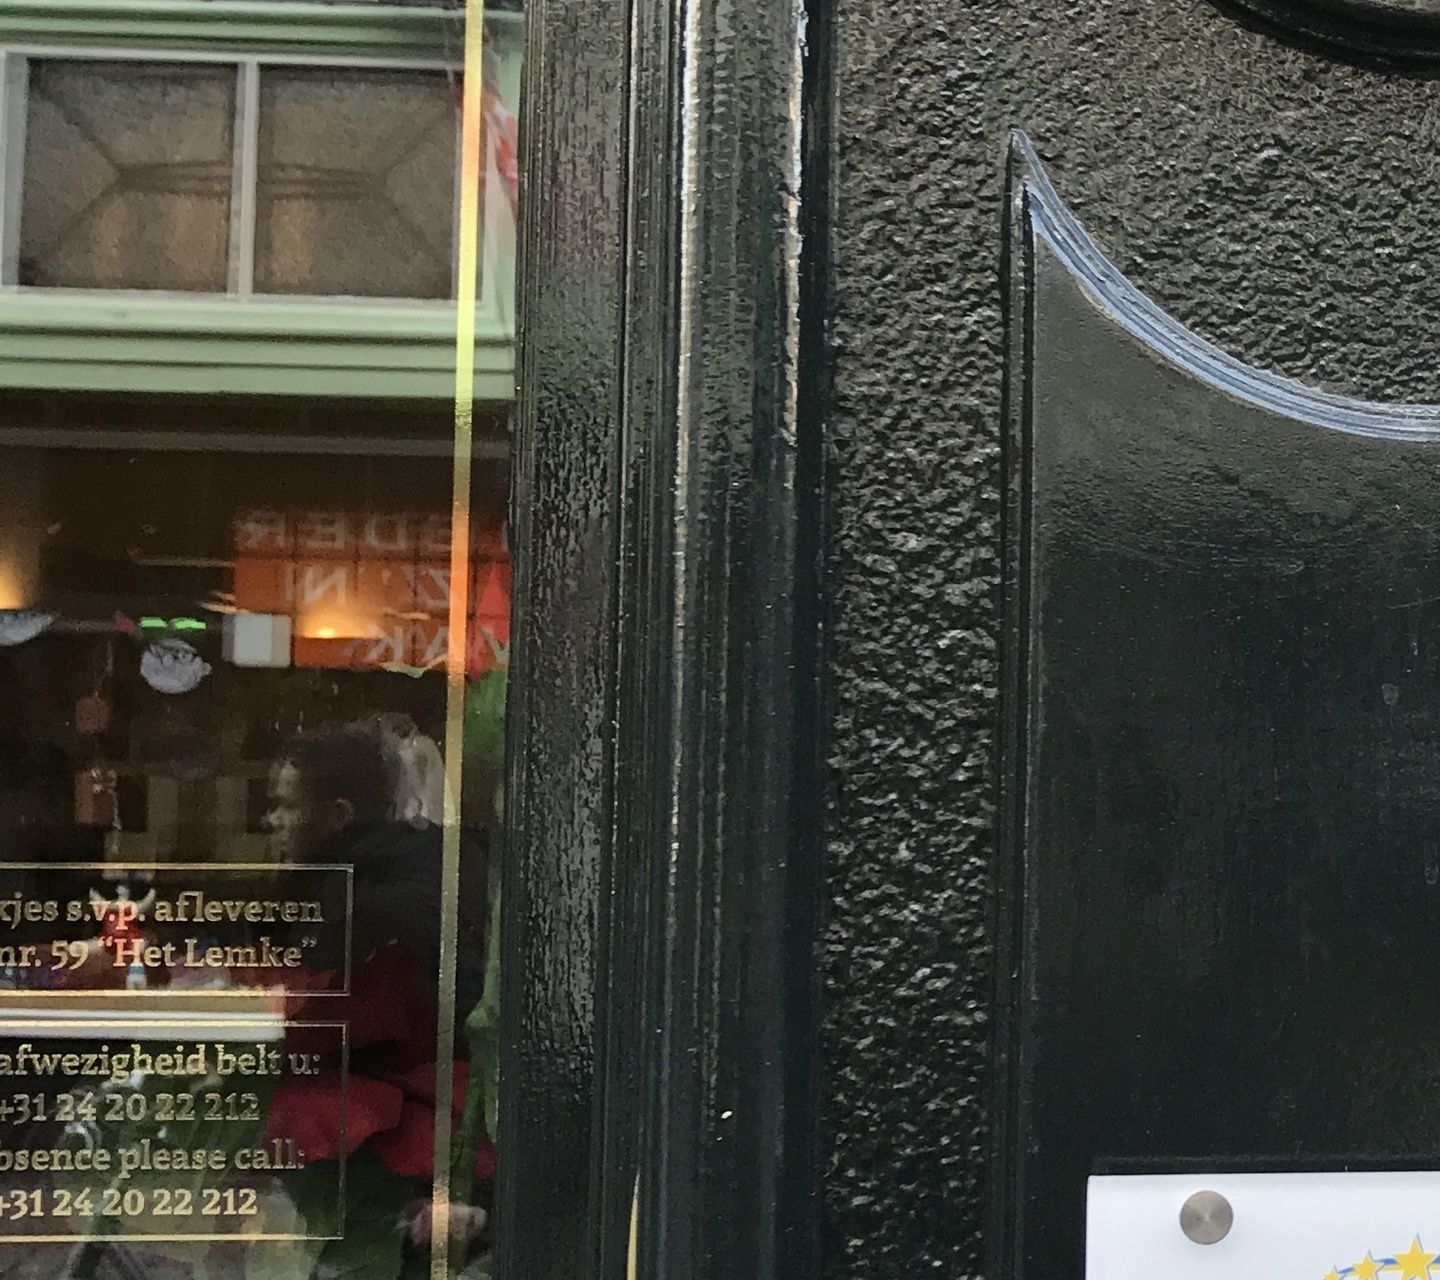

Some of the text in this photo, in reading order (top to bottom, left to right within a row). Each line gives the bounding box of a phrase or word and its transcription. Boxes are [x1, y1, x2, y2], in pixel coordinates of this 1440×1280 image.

[154, 891, 323, 922] afleveren
[51, 941, 89, 970] 59
[217, 1044, 281, 1075] belt
[290, 1051, 320, 1075] u:
[56, 1091, 97, 1121] 24
[105, 1093, 147, 1121] 20
[155, 1093, 195, 1121] 22
[204, 1093, 260, 1121] 212
[119, 1139, 226, 1178] please
[234, 1139, 305, 1170] call:
[52, 1188, 94, 1216] 24
[102, 1189, 145, 1216] 20
[153, 1189, 193, 1216] 22
[202, 1189, 258, 1216] 212
